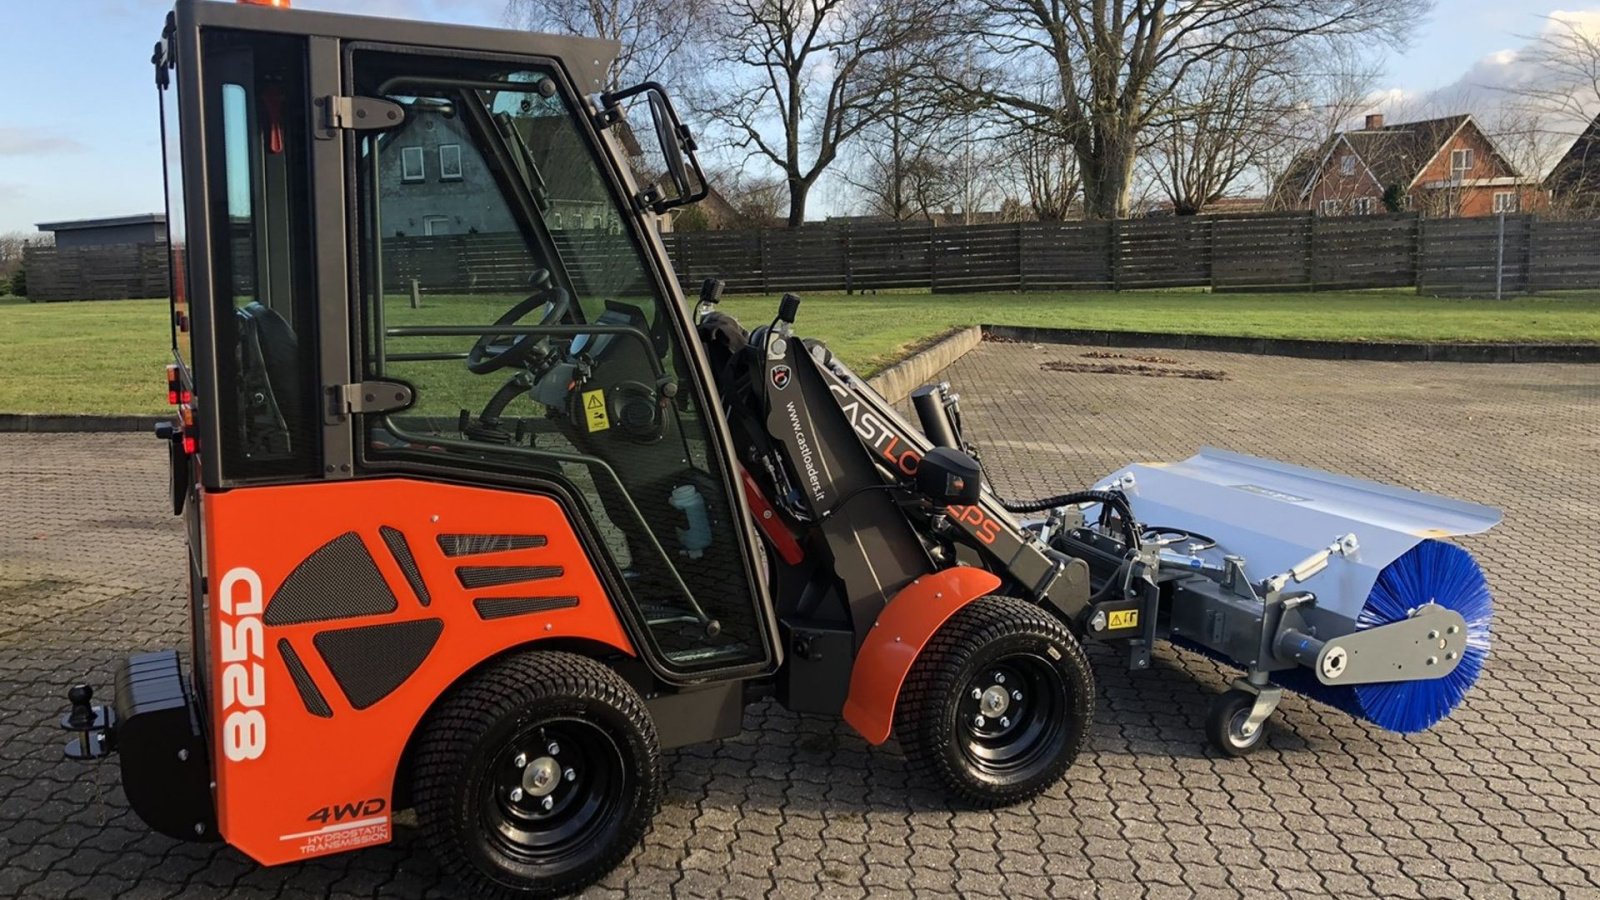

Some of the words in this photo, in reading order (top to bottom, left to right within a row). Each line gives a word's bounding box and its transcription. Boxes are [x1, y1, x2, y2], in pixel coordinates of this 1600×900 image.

[786, 401, 825, 501] www.castloaders.it
[219, 566, 266, 762] 825D
[306, 798, 386, 823] 4WD
[300, 832, 388, 854] TRANSMISSION
[308, 824, 387, 845] HYDROSTATIC
